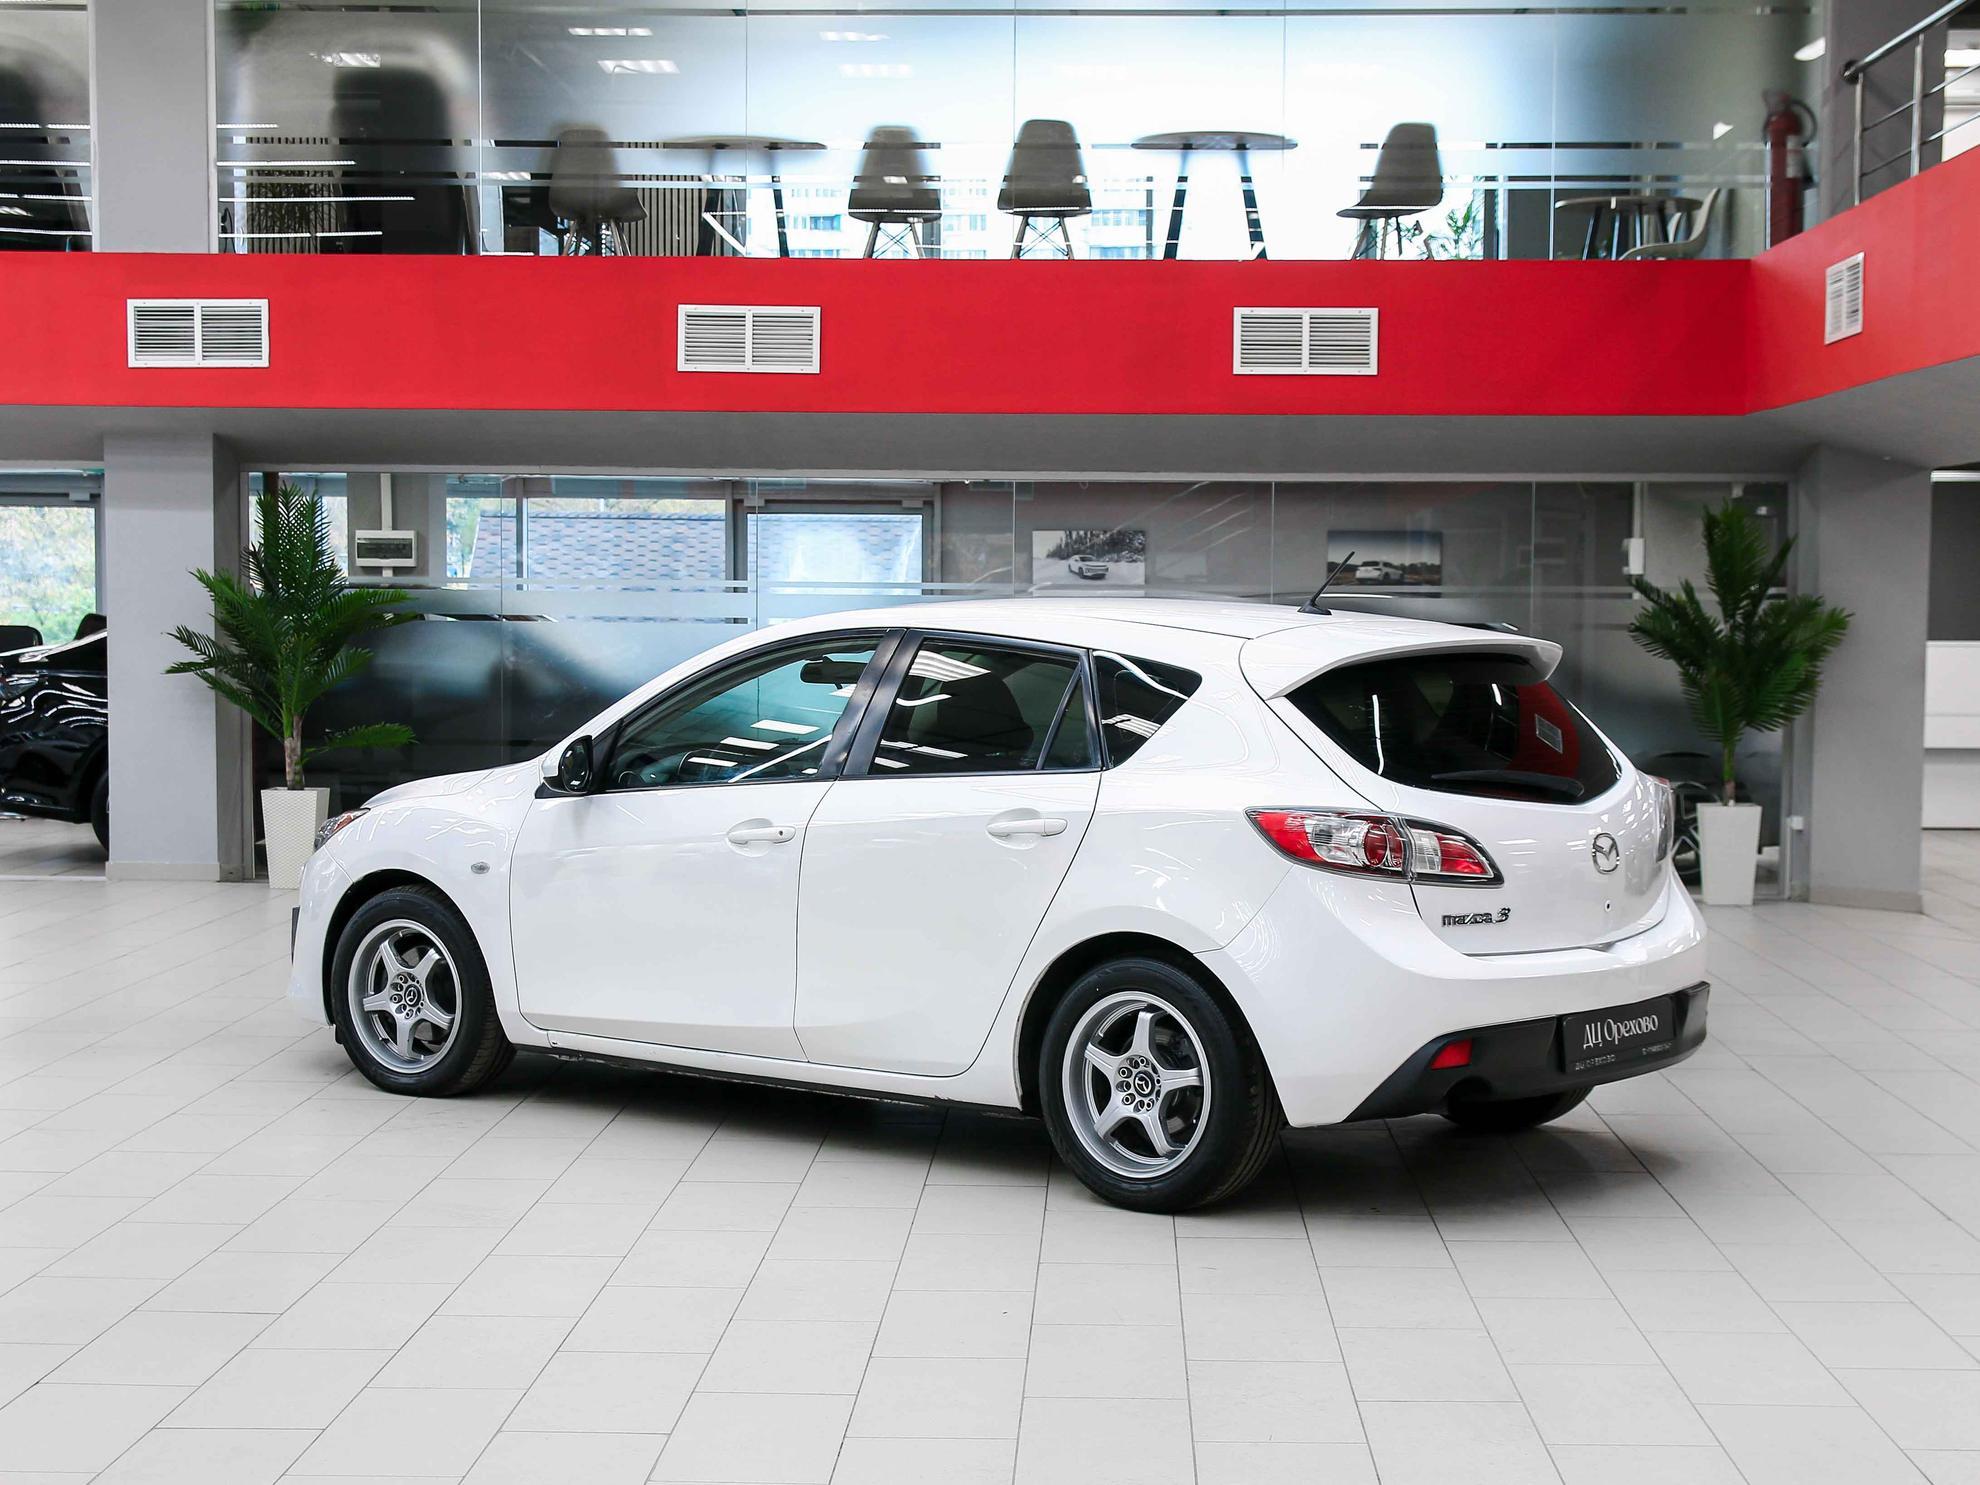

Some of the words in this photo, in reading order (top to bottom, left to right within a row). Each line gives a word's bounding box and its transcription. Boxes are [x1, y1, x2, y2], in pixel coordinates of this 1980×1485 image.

[1495, 907, 1511, 923] 3
[1583, 1022, 1603, 1050] ДЦ
[1604, 1015, 1659, 1045] Орехово
